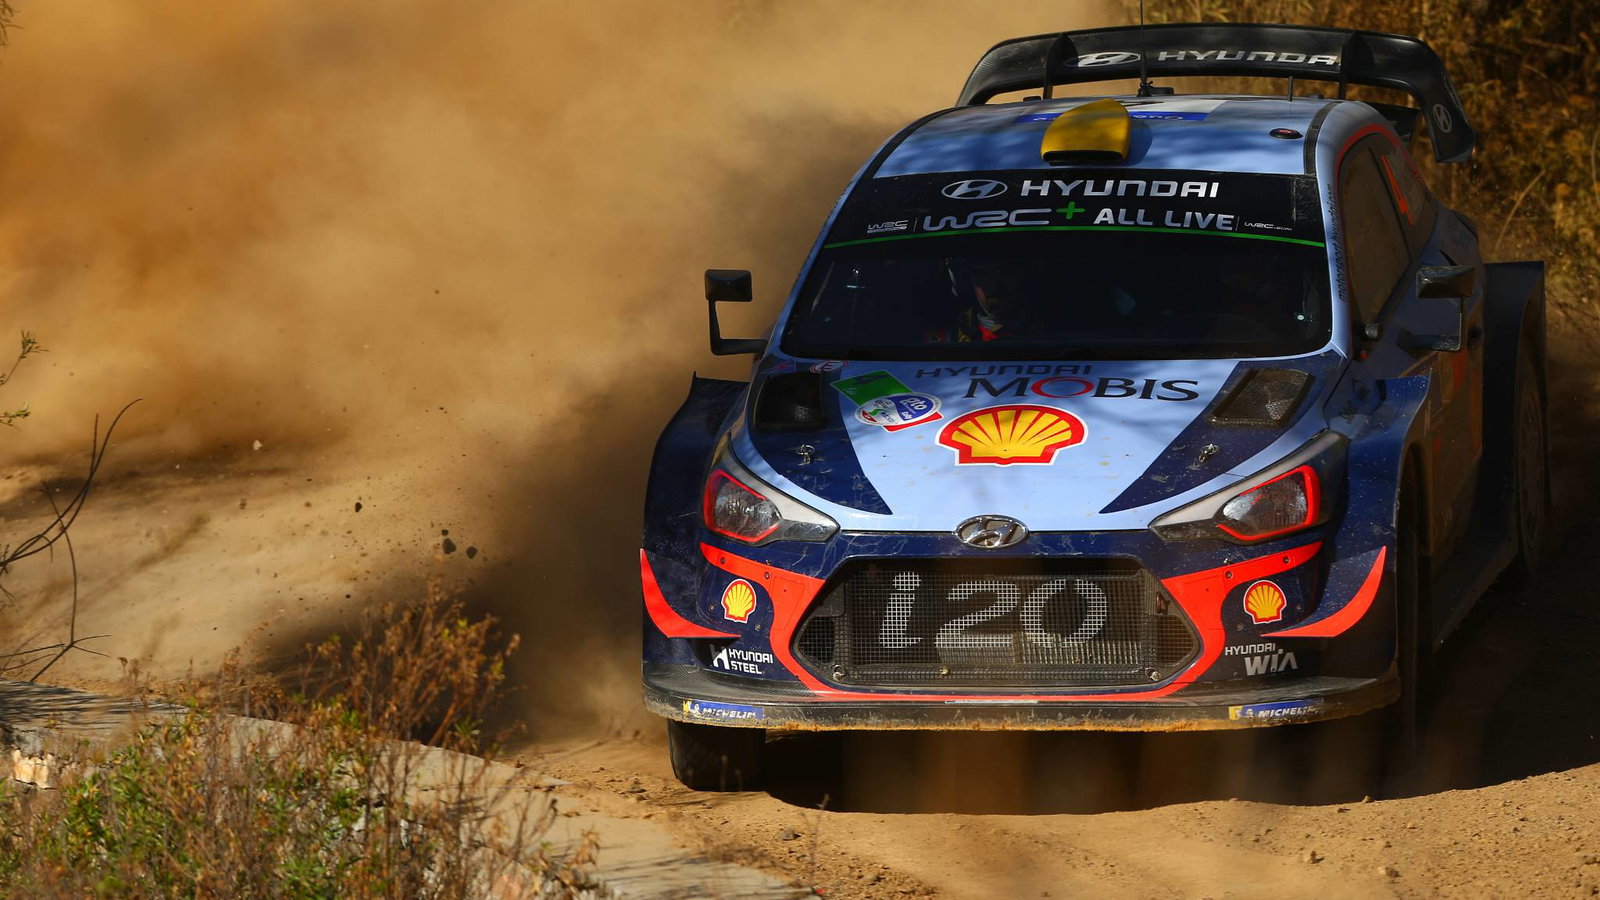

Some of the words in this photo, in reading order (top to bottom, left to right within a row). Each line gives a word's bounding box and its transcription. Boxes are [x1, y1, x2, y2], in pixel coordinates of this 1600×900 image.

[1157, 50, 1341, 66] HYUNDA
[1020, 179, 1220, 198] HYUNDAI
[1093, 208, 1154, 226] ALL
[1164, 210, 1236, 231] LIVE
[914, 365, 1093, 379] HYUNDAI
[963, 376, 1199, 402] MOBIS
[878, 571, 1108, 649] i20
[728, 647, 774, 664] HYUNDAI
[1224, 642, 1276, 656] HYUNDAI
[730, 660, 763, 675] STEEL
[1244, 648, 1299, 676] WIA
[703, 707, 757, 719] MICHELIN
